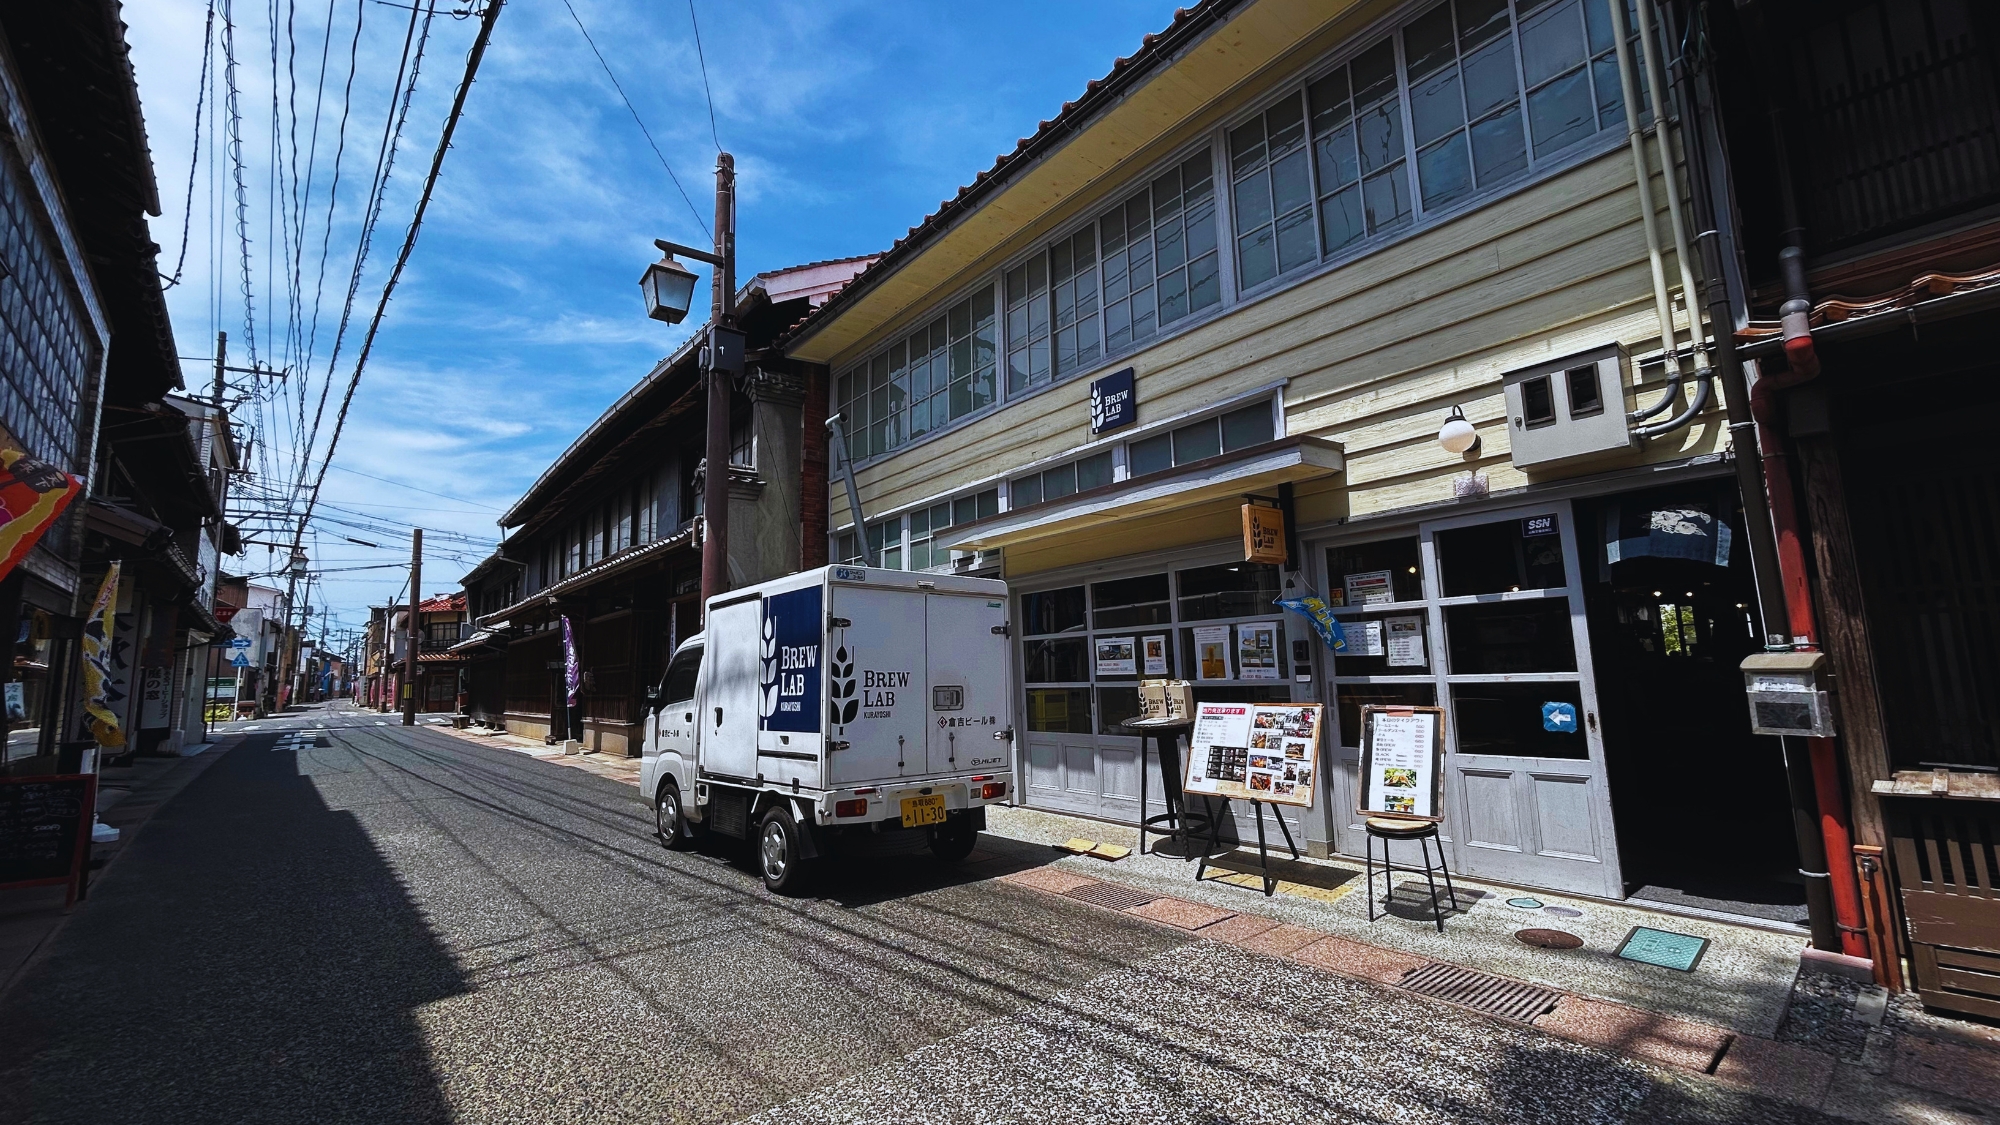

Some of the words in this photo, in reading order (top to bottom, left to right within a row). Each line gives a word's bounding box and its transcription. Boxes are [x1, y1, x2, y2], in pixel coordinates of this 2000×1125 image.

[1104, 389, 1129, 406] BREW
[1105, 403, 1122, 417] LAB
[1528, 517, 1551, 530] SSN
[1262, 526, 1279, 537] BREW
[1263, 535, 1275, 545] LAB
[781, 644, 818, 670] BREW
[780, 672, 805, 697] LAB
[863, 670, 910, 688] BREW
[863, 689, 896, 708] LAB
[780, 701, 801, 712] KURAYOSHI
[863, 711, 891, 719] KURAYOSHI
